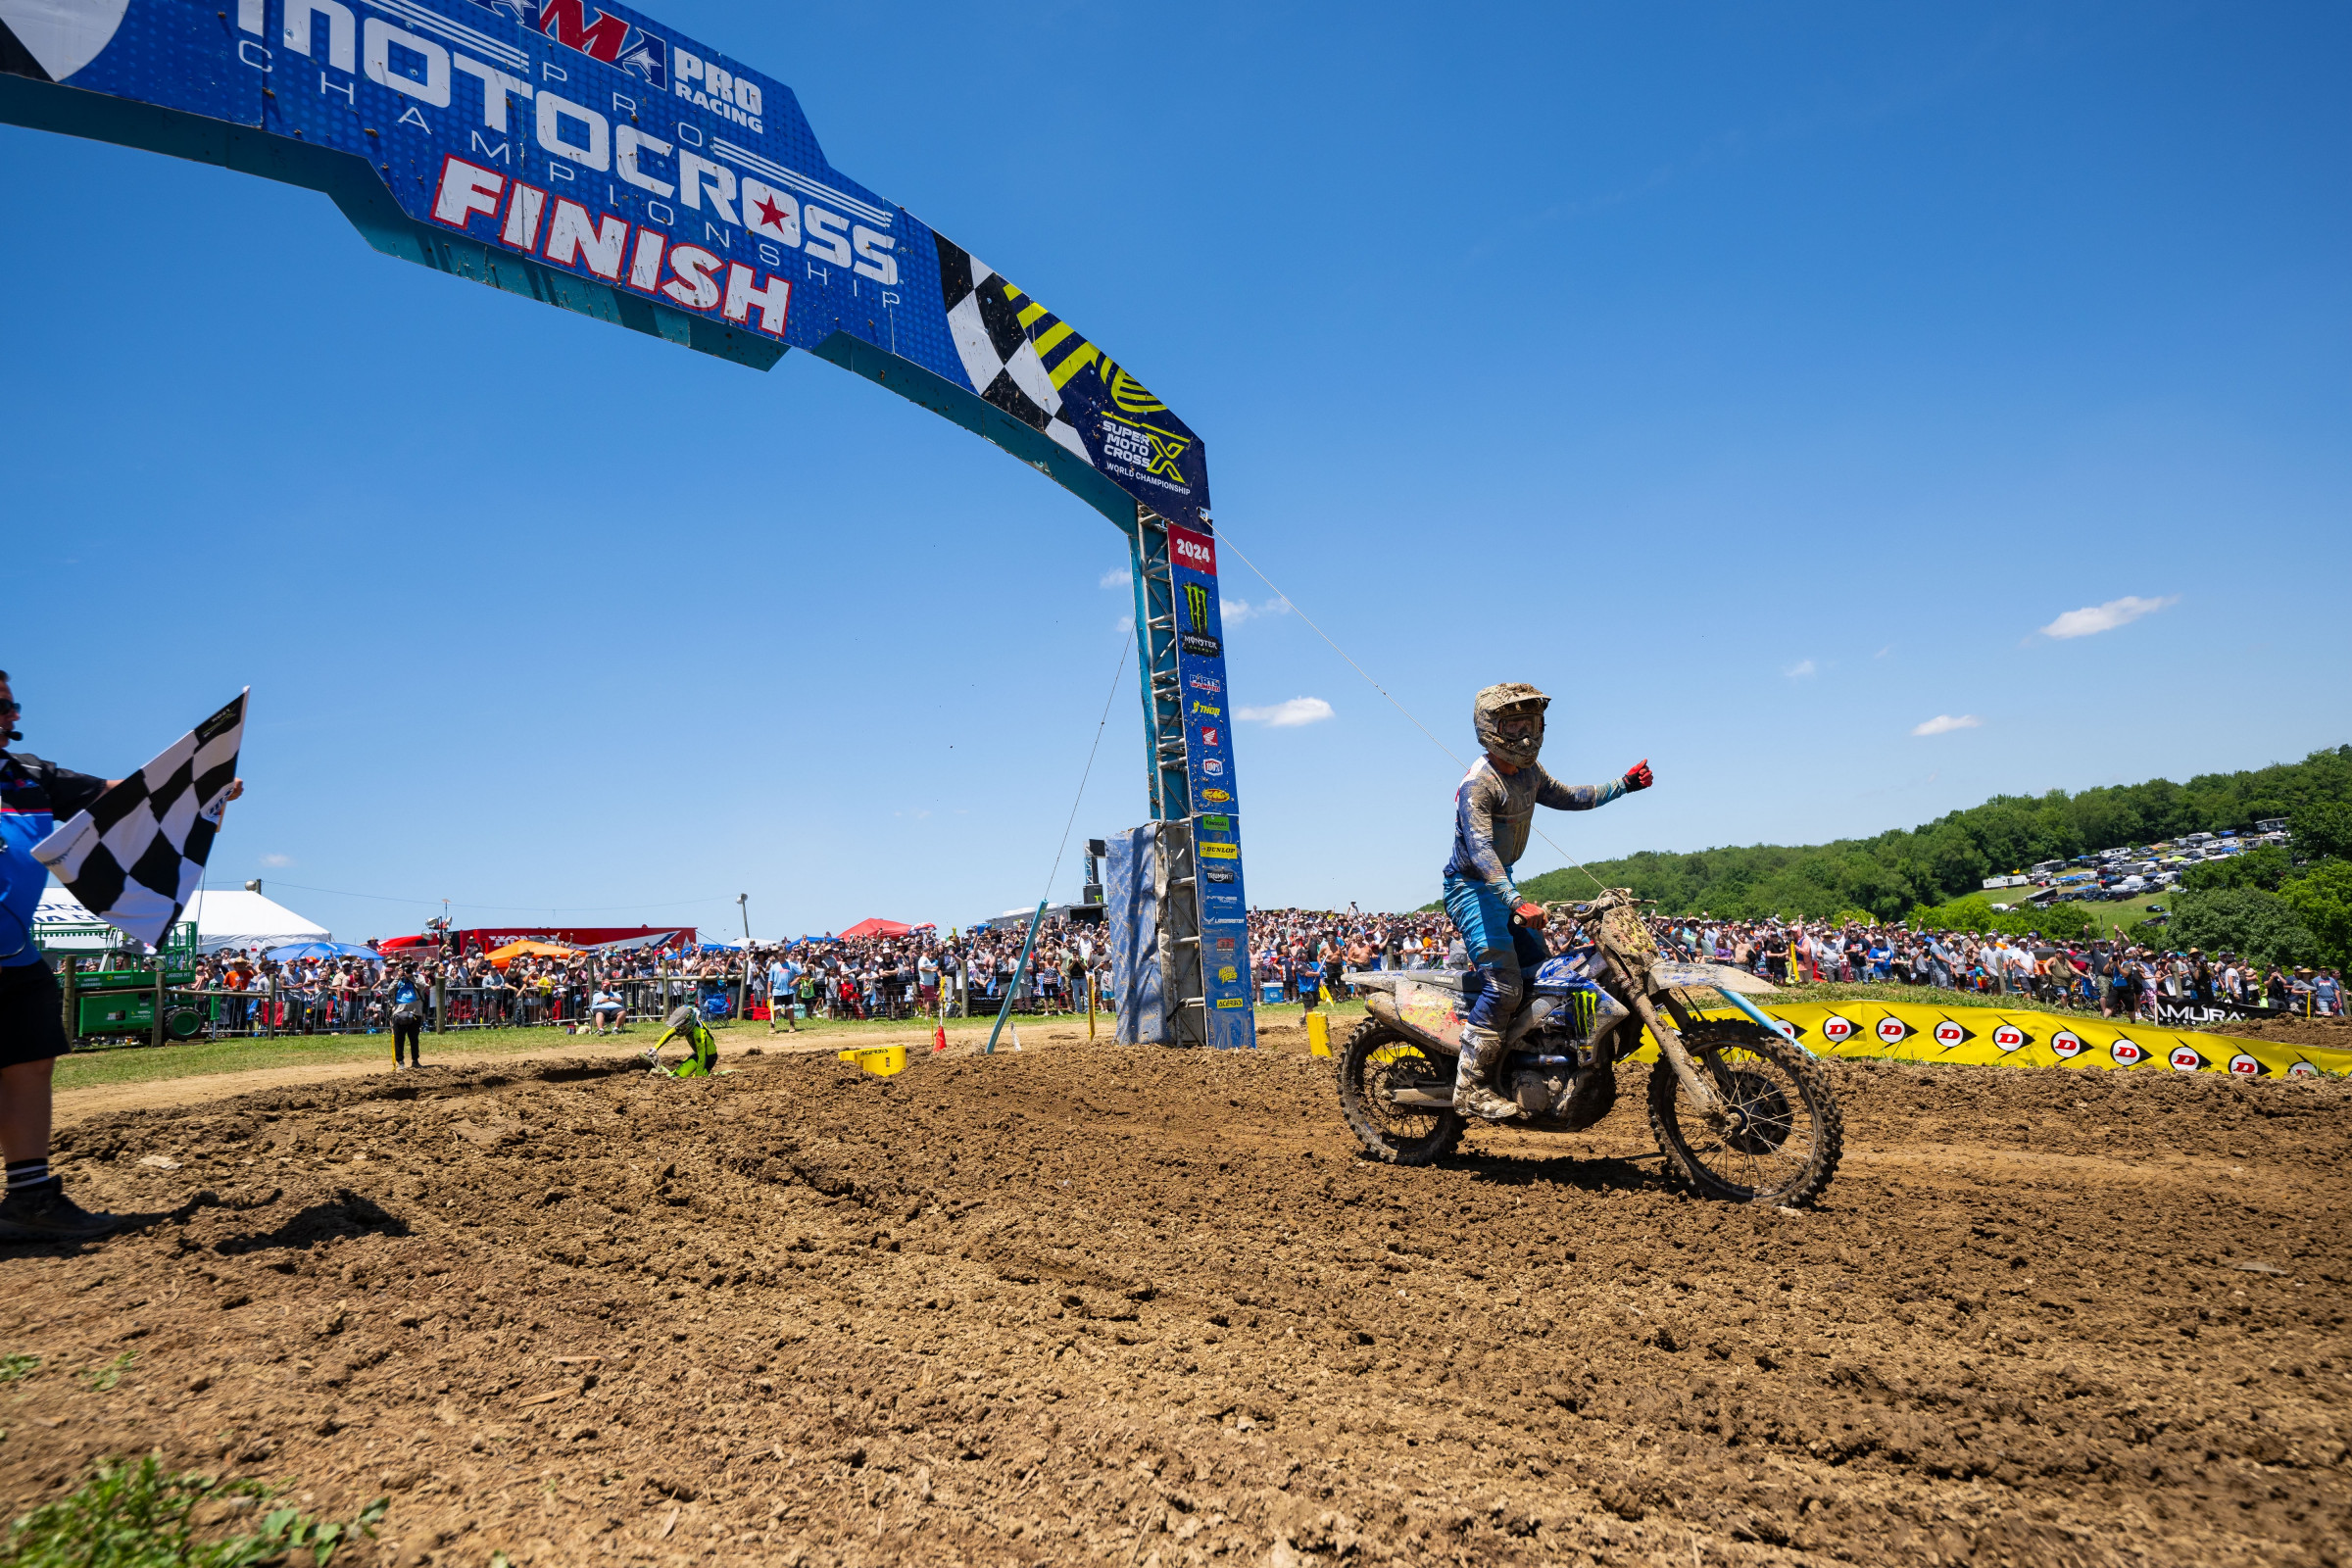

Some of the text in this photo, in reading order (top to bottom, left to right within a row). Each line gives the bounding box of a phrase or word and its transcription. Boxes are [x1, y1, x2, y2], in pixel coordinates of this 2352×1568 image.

[674, 46, 762, 118] PRO
[675, 80, 763, 134] RACING
[238, 40, 901, 309] CHAMPIONSHIP
[429, 153, 793, 338] FINISH
[1102, 420, 1151, 447] SUPER
[1106, 433, 1150, 457] MOTO
[1103, 444, 1151, 467] CROSS
[1106, 462, 1191, 496] WORLD CHAMPIONSHIP
[1176, 538, 1210, 563] 2024
[1184, 635, 1218, 650] MONSTER
[1190, 674, 1220, 686] PARTS
[1200, 705, 1221, 715] THOR
[1218, 965, 1236, 978] MOTO
[1218, 999, 1243, 1007] ACERBIS
[1828, 1023, 1848, 1035] D
[1881, 1024, 1903, 1035] D
[1937, 1028, 1961, 1040] D
[1997, 1032, 2020, 1045] D
[2054, 1038, 2077, 1051] D
[2115, 1046, 2137, 1058] D
[2174, 1054, 2197, 1066] D
[2232, 1061, 2256, 1074] D
